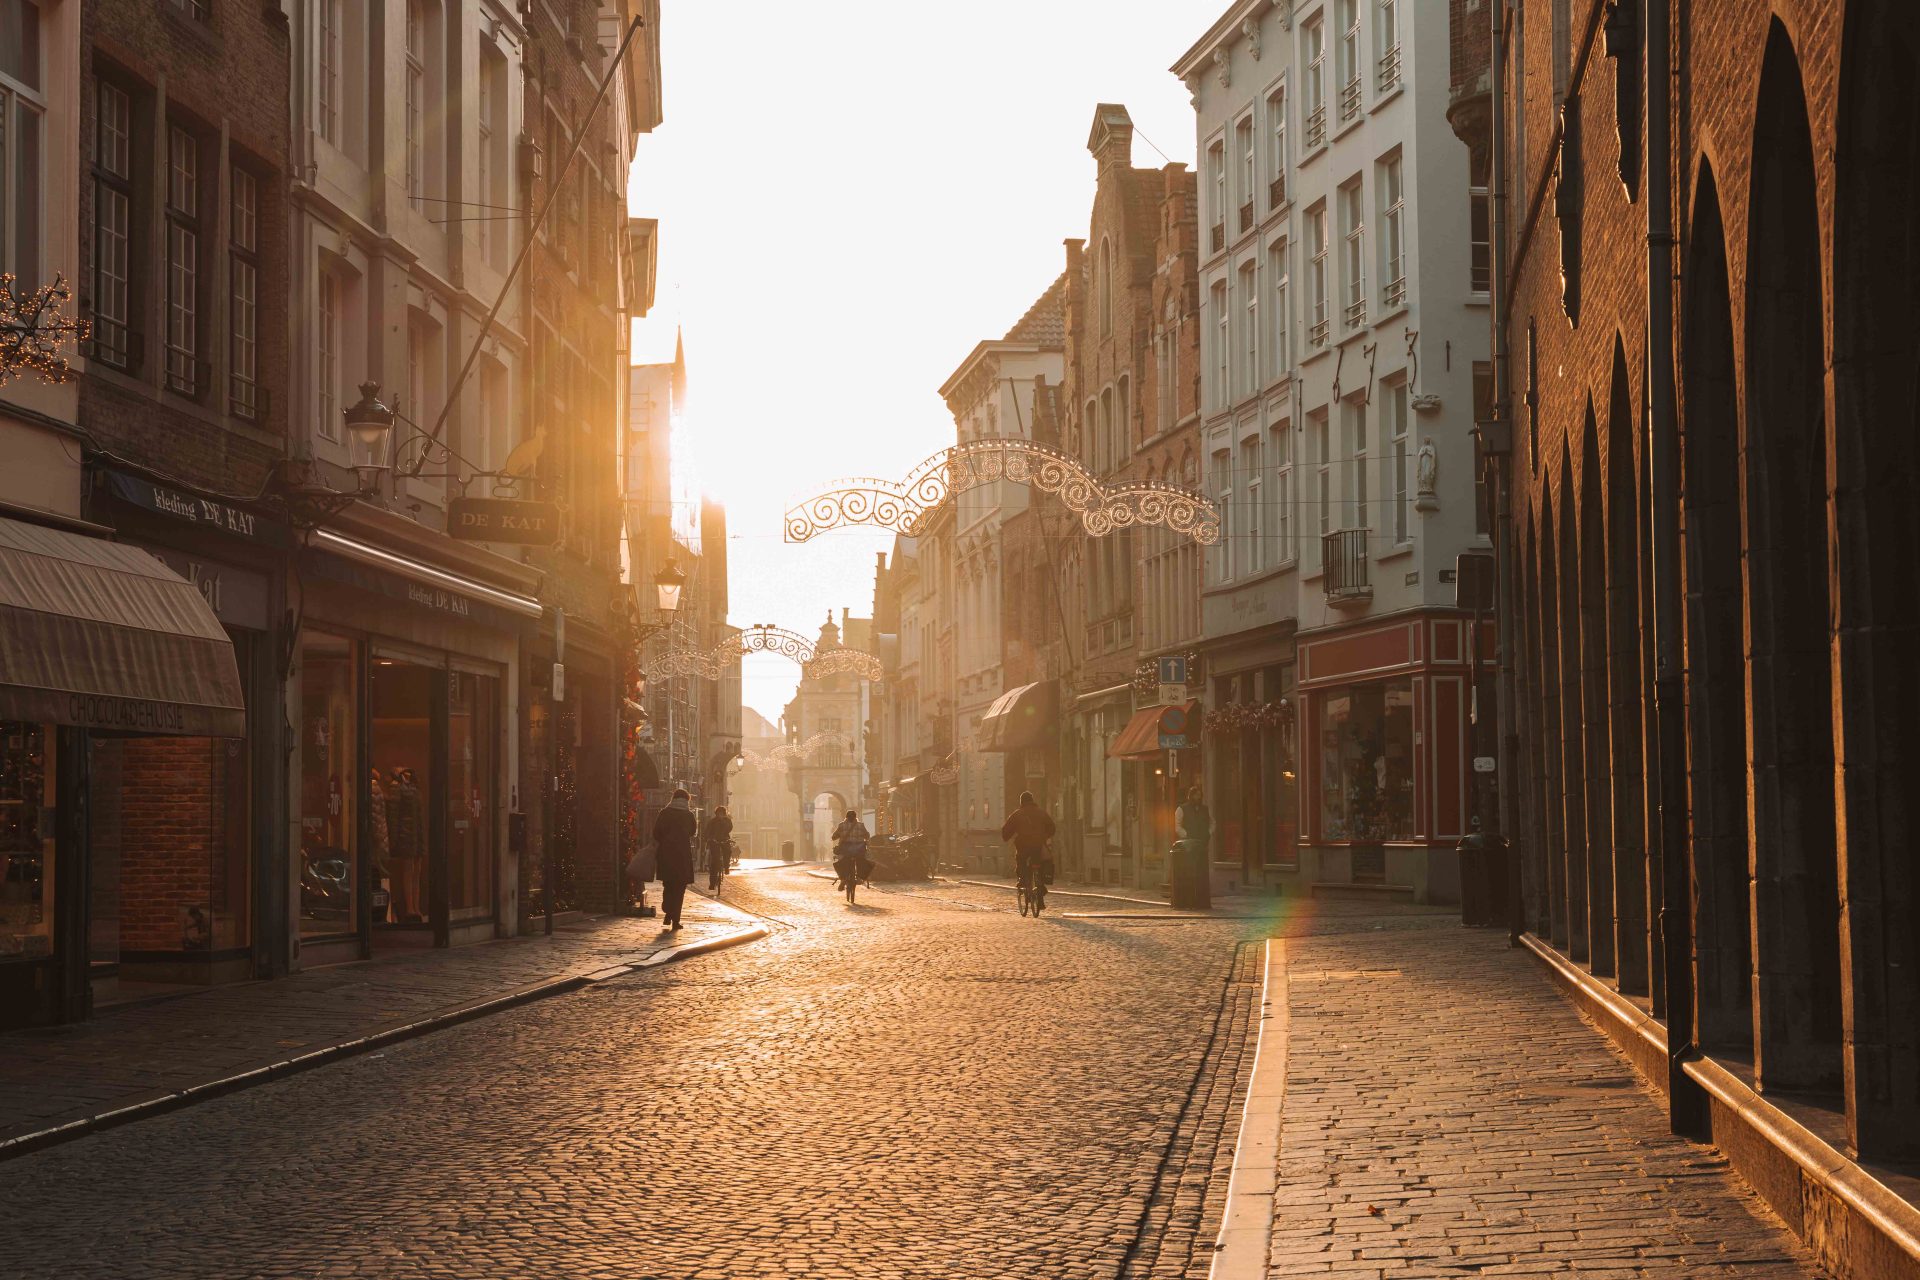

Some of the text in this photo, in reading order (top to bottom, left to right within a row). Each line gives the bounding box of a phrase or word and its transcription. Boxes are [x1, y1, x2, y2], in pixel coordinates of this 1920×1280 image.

[153, 487, 255, 536] kleding DE KAT
[461, 512, 545, 531] DE KAT
[408, 583, 469, 616] kleding DE KAT
[69, 694, 184, 730] CHOCOLADEHUISJE
